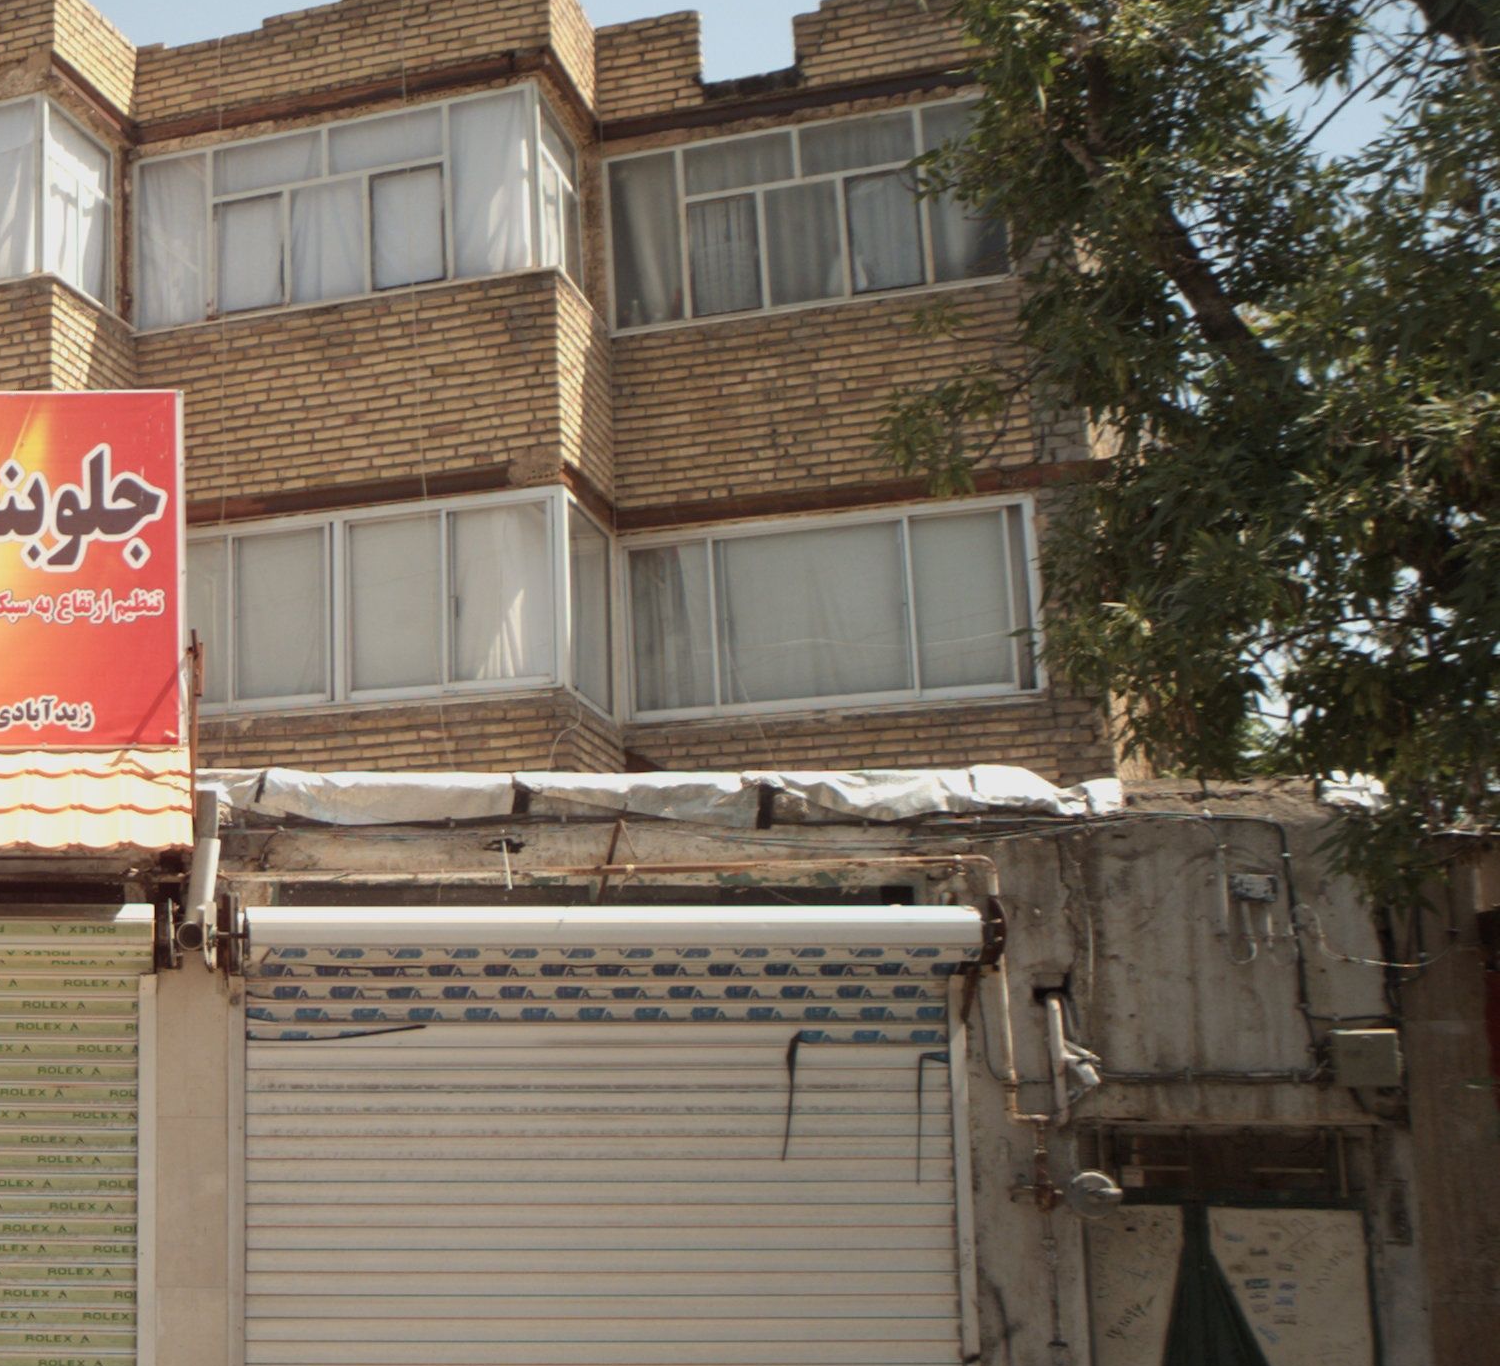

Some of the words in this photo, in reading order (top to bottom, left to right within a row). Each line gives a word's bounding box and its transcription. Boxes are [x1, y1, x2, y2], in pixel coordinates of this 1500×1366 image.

[34, 598, 51, 621] به
[55, 590, 110, 623] ارتفاع
[113, 590, 164, 622] تنظیم
[63, 978, 111, 988] ROLEX
[14, 1021, 62, 1031] ROLEX
[36, 1065, 84, 1075] ROLEX
[0, 1087, 47, 1097] ROLEX
[48, 1201, 96, 1211] ROLEX
[1, 1223, 49, 1233] ROLEX
[3, 1288, 51, 1298] ROLEX
[25, 1333, 73, 1343] ROLEX
[37, 1358, 85, 1366] ROLEX
